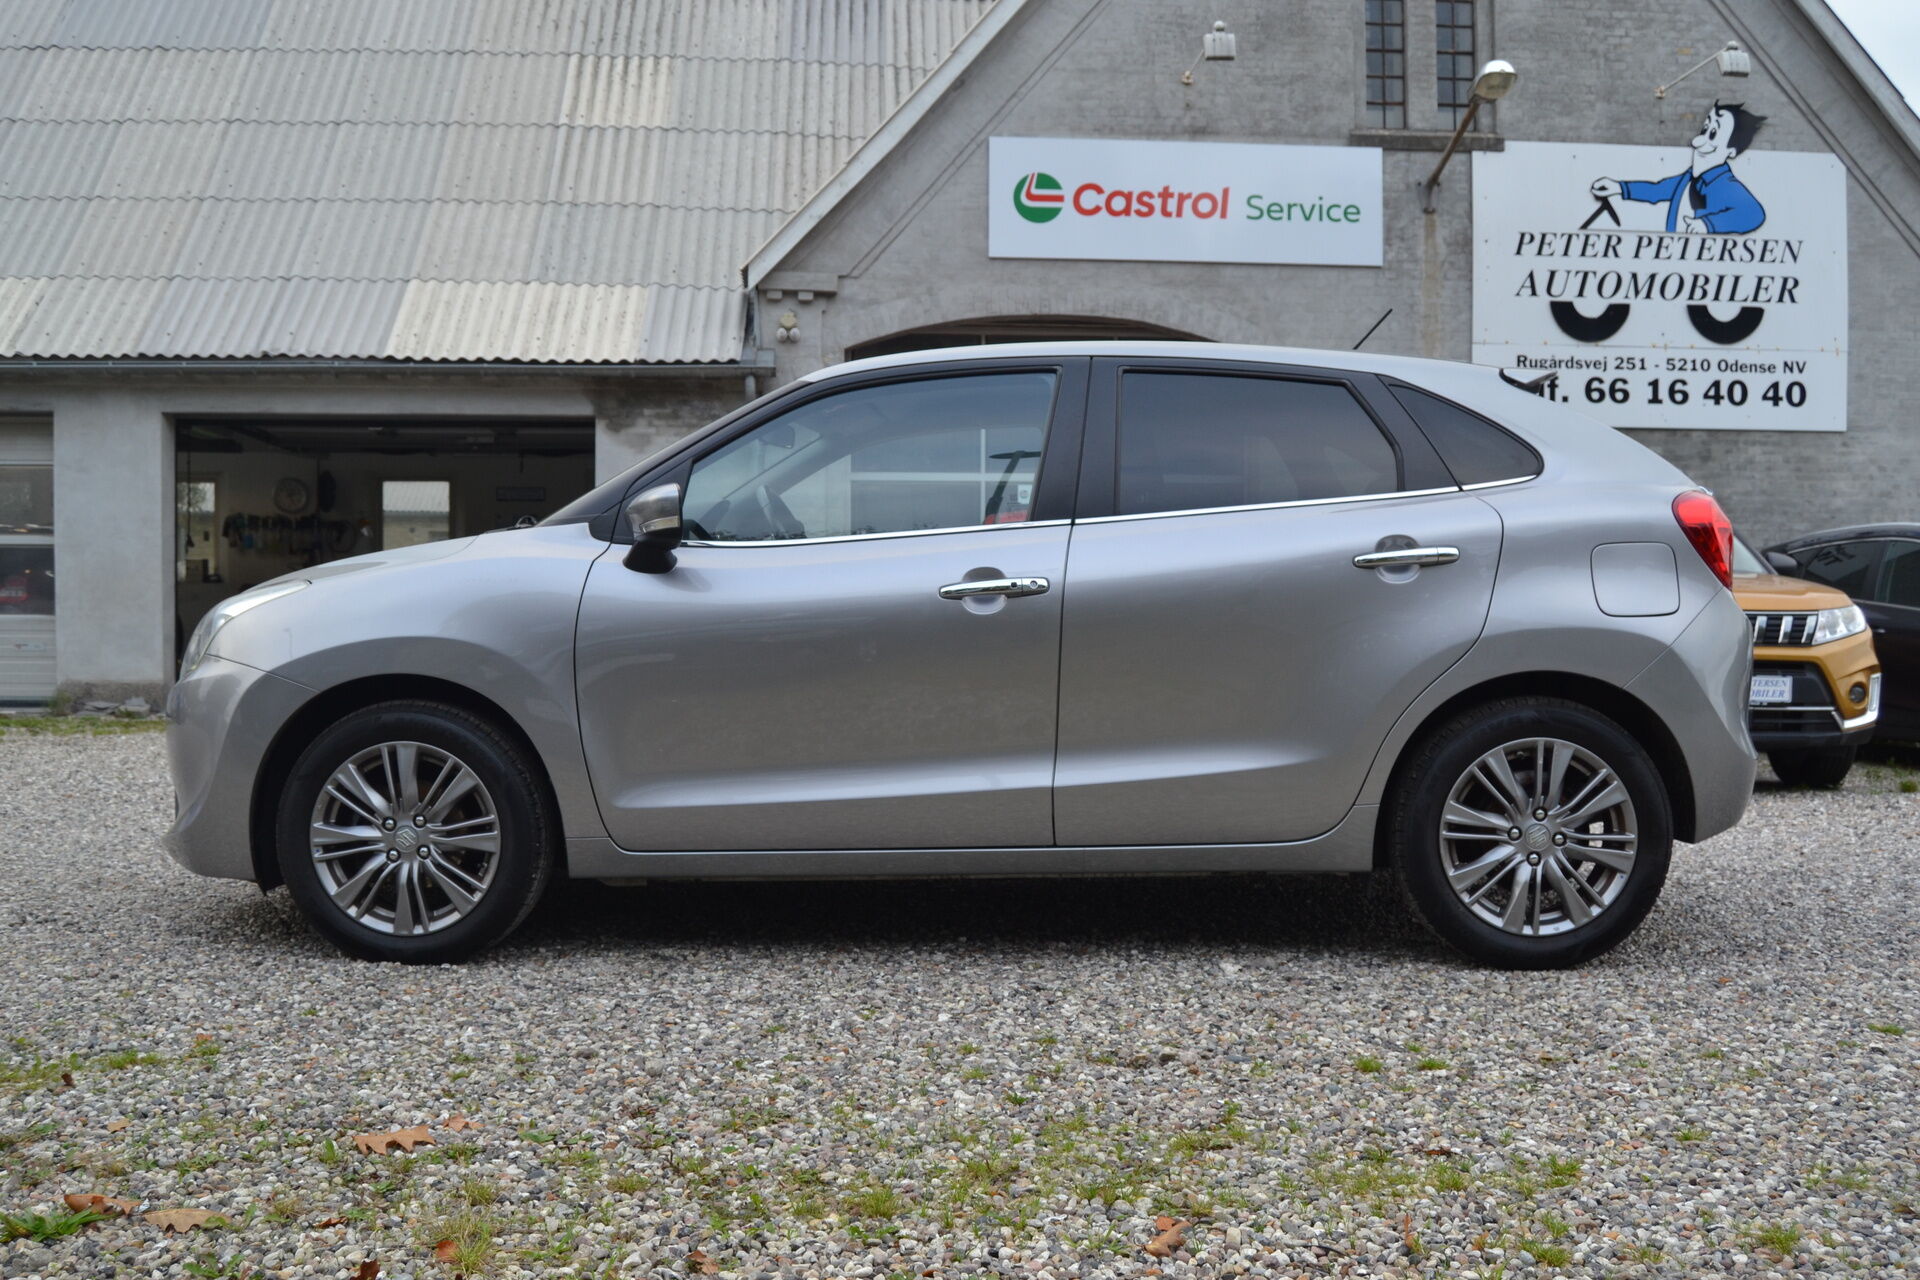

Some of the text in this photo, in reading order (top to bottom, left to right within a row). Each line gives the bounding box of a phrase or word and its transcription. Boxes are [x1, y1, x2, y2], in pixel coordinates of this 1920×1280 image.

[1073, 183, 1361, 223] Castrol Service
[1514, 231, 1804, 264] PETER PETERSEN
[1514, 269, 1800, 304] AUTOMOBILER
[1516, 354, 1608, 372] Rugårdsvej
[1614, 357, 1647, 370] 251
[1666, 358, 1711, 372] 5210
[1717, 359, 1777, 374] Odense
[1783, 360, 1807, 374] NV
[1585, 376, 1630, 404] 66
[1647, 378, 1690, 405] 16
[1703, 379, 1749, 407] 40
[1761, 381, 1807, 408] 40
[1753, 679, 1787, 687] TERSEN
